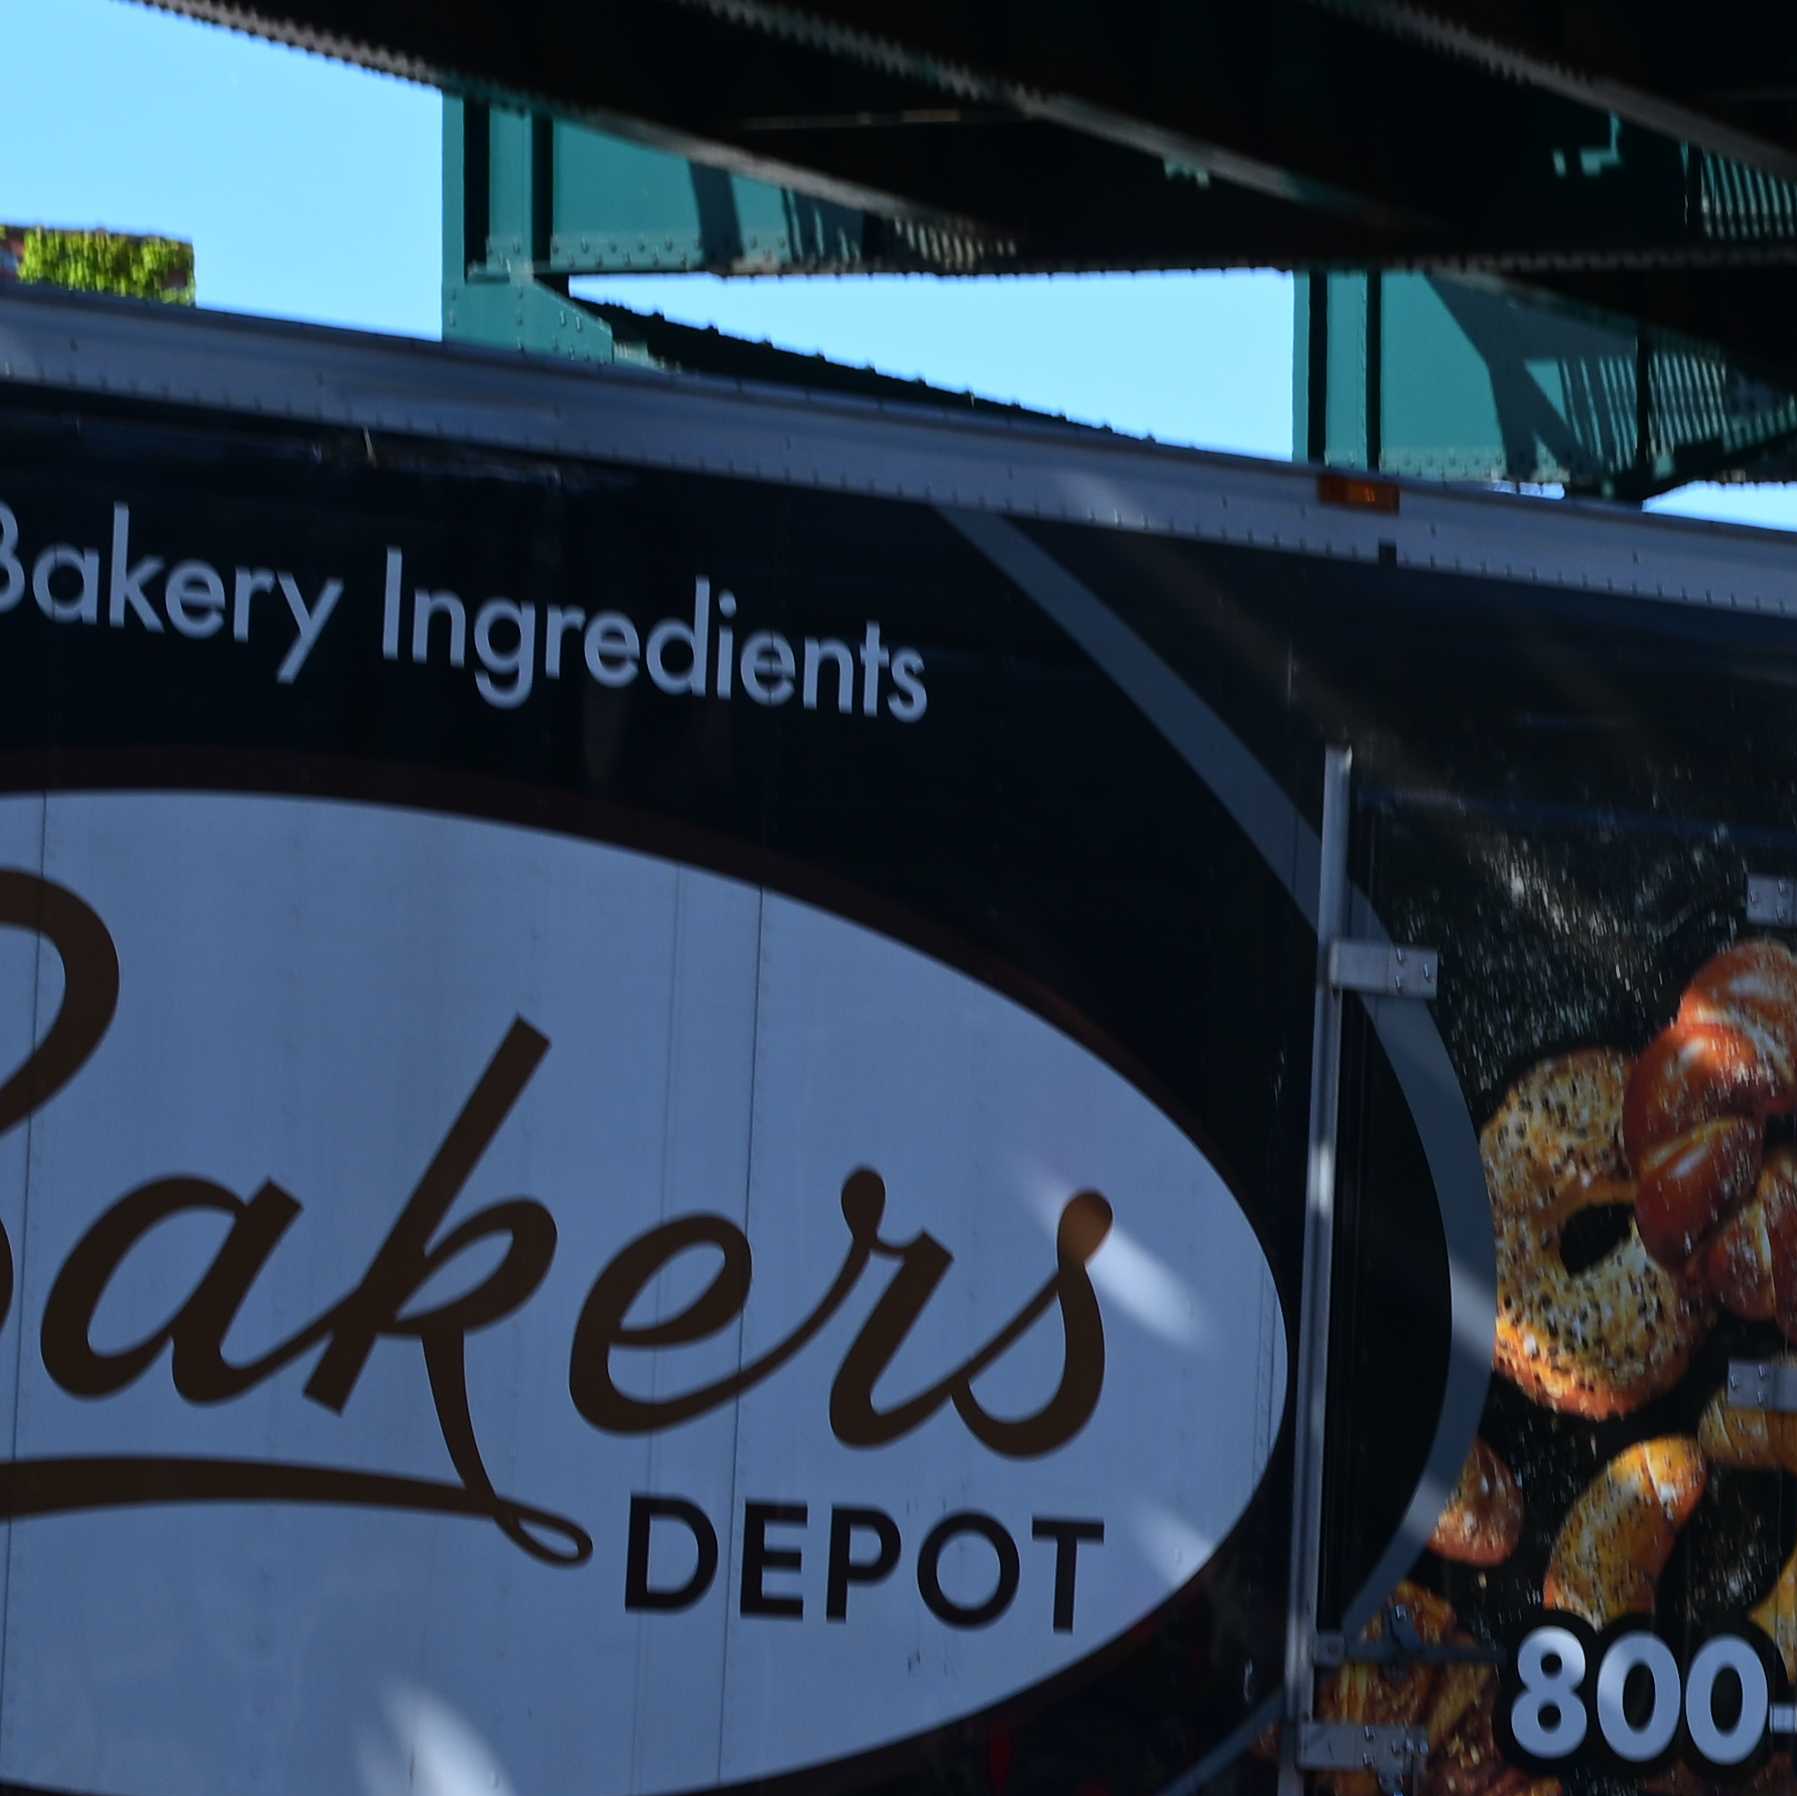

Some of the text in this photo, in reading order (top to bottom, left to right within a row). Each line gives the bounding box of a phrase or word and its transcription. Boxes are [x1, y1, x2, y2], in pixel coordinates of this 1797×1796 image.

[382, 547, 928, 723] Ingredients
[0, 866, 1113, 1567] akers
[624, 1492, 1106, 1633] DEPOT
